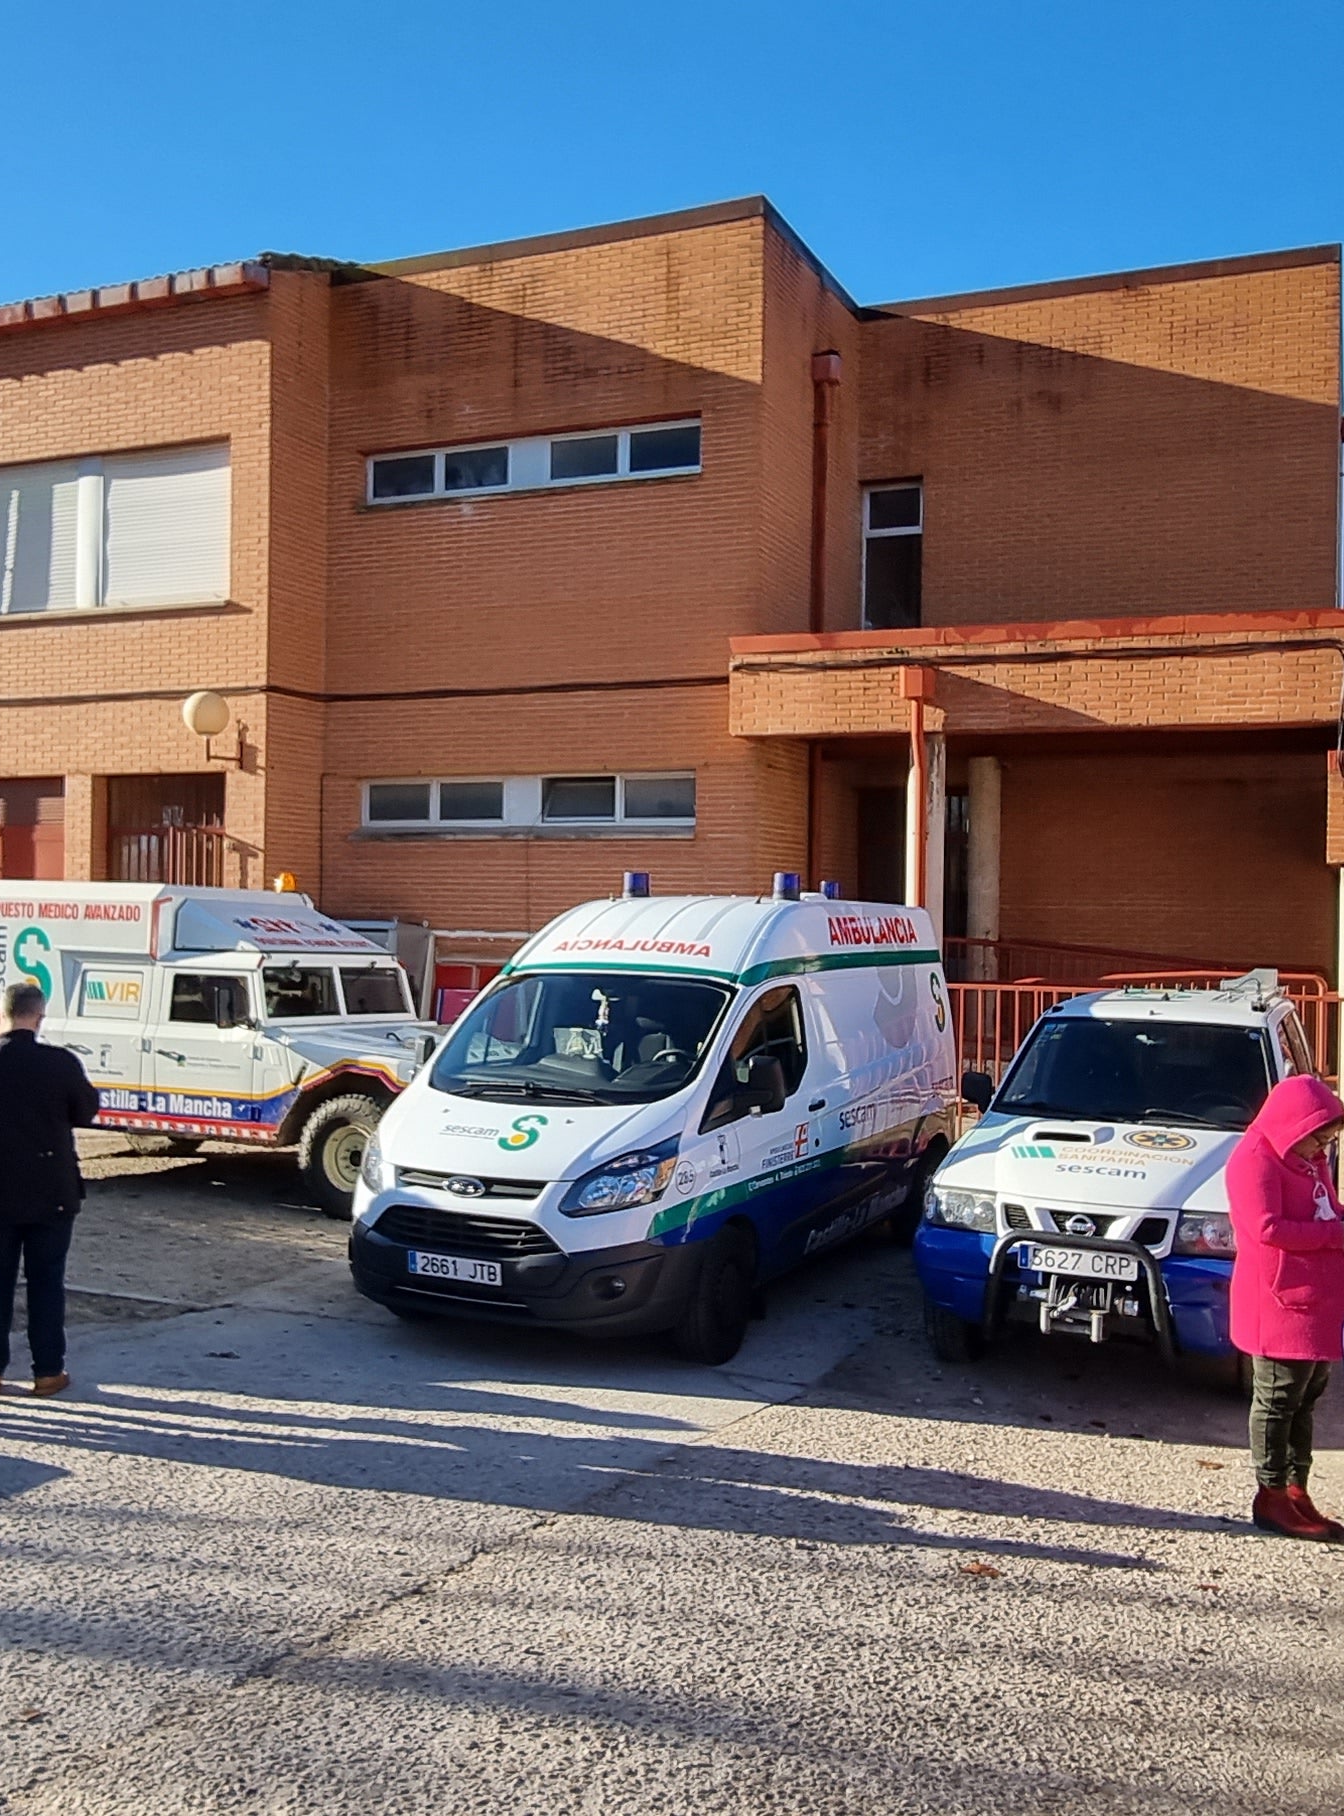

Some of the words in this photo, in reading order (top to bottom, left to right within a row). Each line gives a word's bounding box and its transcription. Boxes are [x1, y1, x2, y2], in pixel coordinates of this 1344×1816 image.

[38, 903, 80, 920] MEDICO
[84, 904, 142, 922] AVANZADO
[827, 916, 919, 946] AMBULANCIA
[106, 980, 140, 1003] VIR
[169, 1093, 233, 1119] Mancha
[838, 1103, 876, 1131] sescam
[443, 1123, 499, 1138] sescam
[1058, 1152, 1147, 1167] SANITARIA
[1062, 1146, 1195, 1166] COORDINACION
[1055, 1163, 1147, 1181] sescam
[420, 1256, 458, 1276] 2661
[468, 1263, 498, 1283] JTB
[1032, 1248, 1083, 1271] 5627
[1091, 1254, 1131, 1276] CRP
